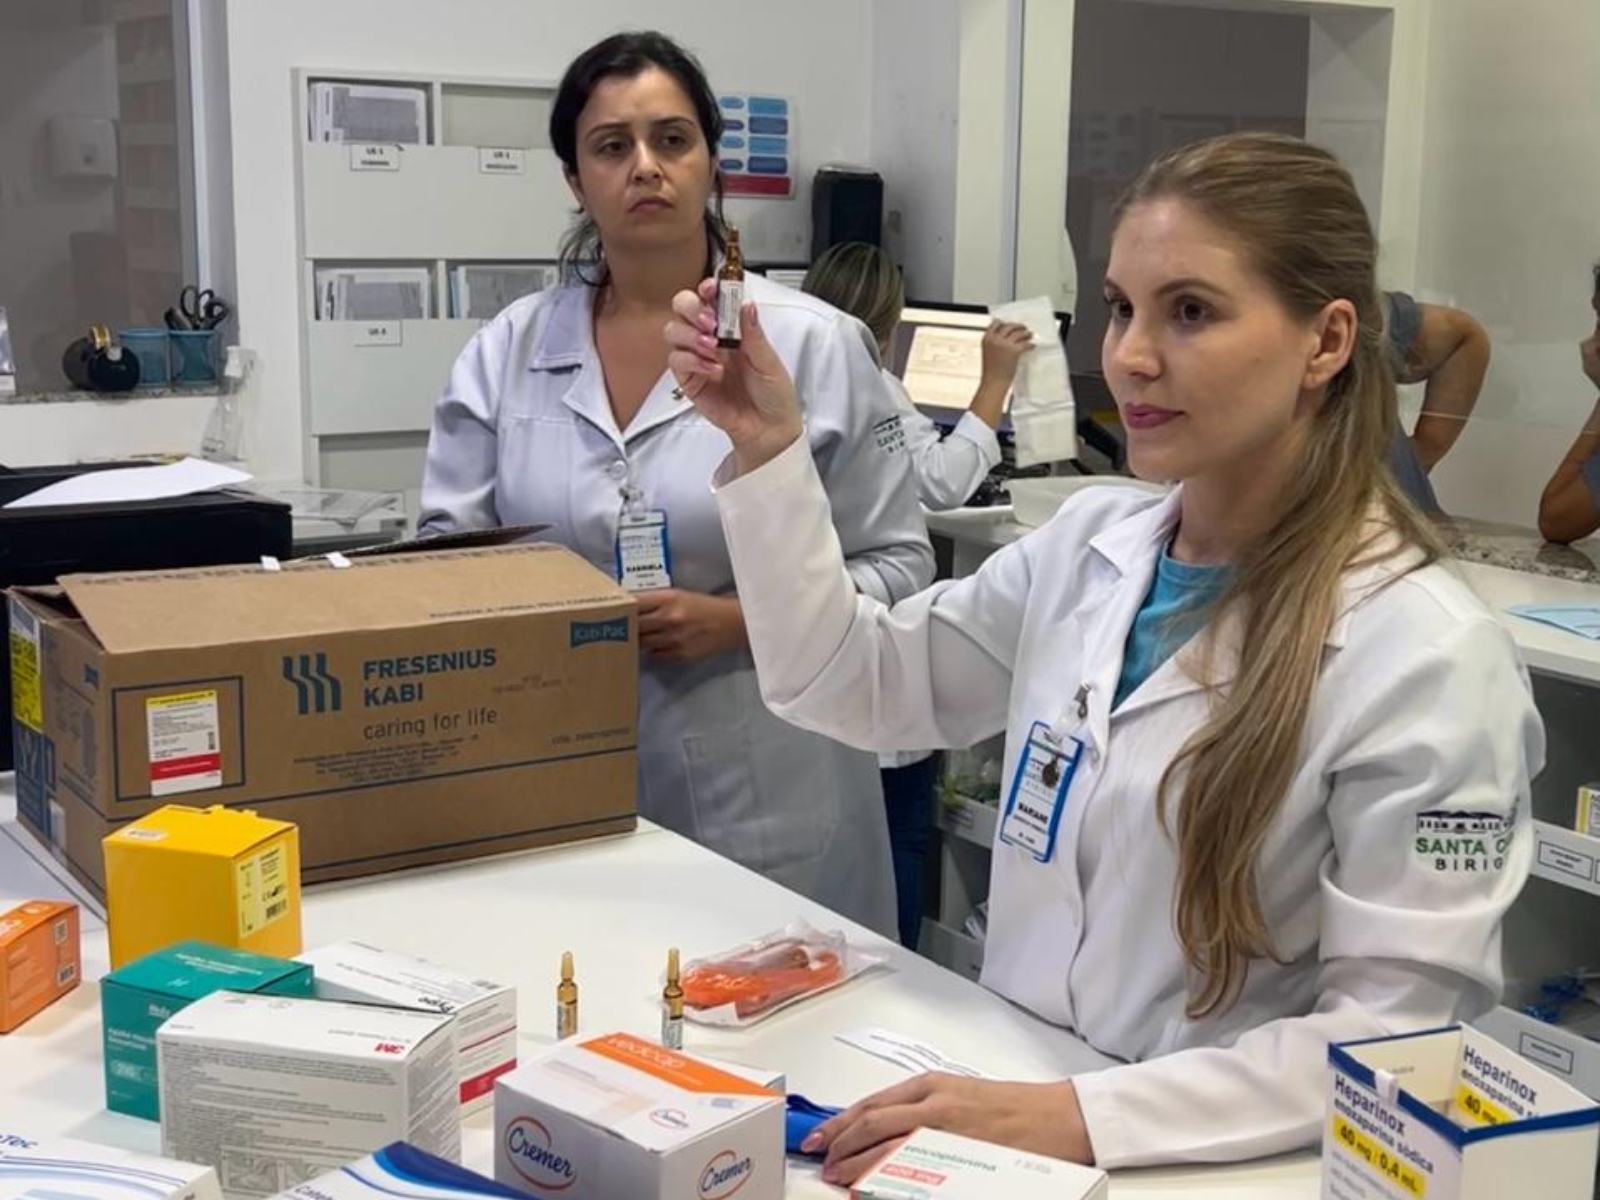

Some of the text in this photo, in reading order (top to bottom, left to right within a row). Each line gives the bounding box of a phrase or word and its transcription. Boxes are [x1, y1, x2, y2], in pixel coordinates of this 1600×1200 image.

[363, 648, 497, 680] FRESENIUS
[364, 683, 424, 707] KABI
[363, 707, 498, 741] caring for life
[1415, 837, 1486, 856] SANTA
[1435, 857, 1504, 872] BIRIG
[1461, 1068, 1524, 1116] enoxaparina
[1463, 1045, 1538, 1106] Heparinox
[1335, 1072, 1405, 1137] Heparinox
[1464, 1094, 1481, 1114] 40
[0, 1134, 38, 1149] Tec
[507, 1127, 573, 1178] Cremer
[1334, 1098, 1395, 1147] enoxaparina
[1397, 1142, 1434, 1175] sódica
[1340, 1125, 1356, 1146] 40
[1356, 1142, 1372, 1162] mg
[1379, 1152, 1399, 1178] 0,4
[700, 1157, 753, 1193] Cremer
